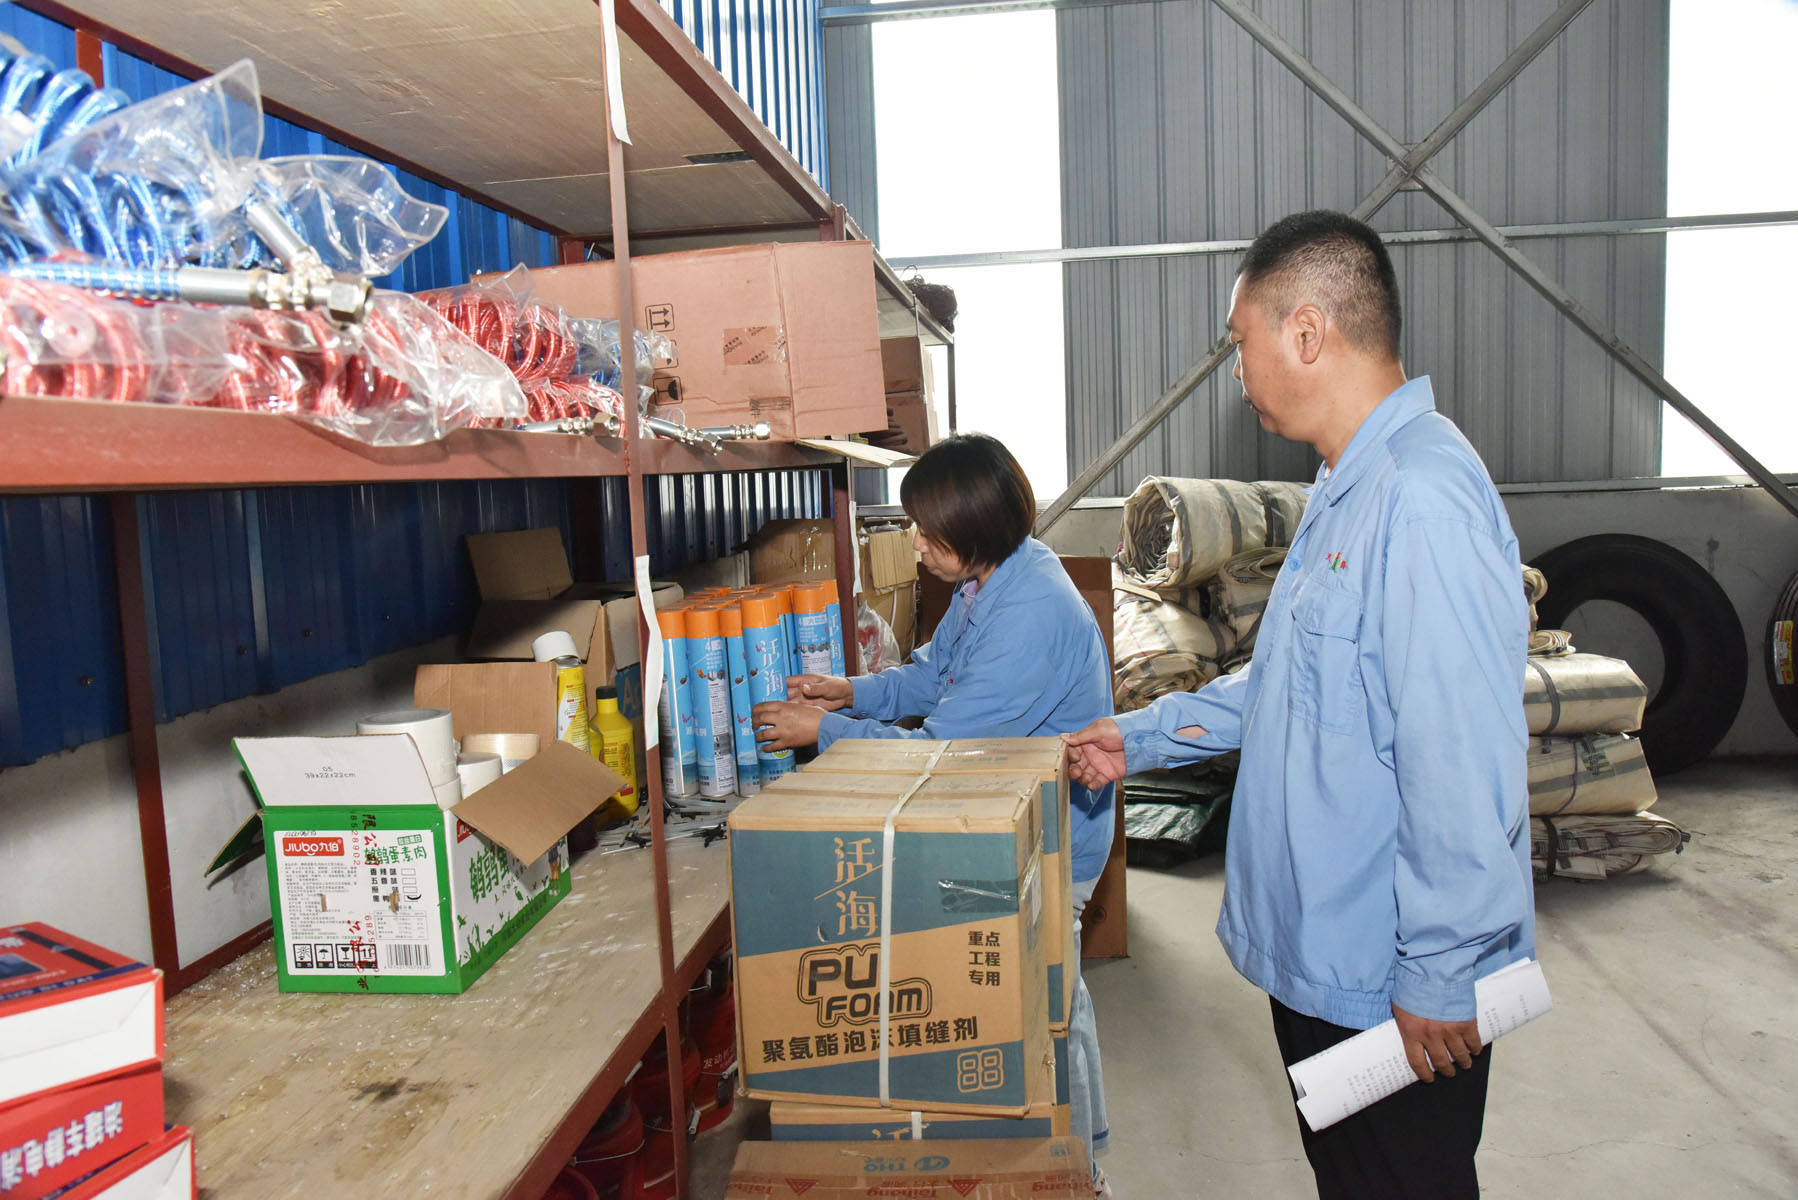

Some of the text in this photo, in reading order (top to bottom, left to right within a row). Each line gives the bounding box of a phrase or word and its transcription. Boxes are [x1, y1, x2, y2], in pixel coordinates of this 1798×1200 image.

[834, 836, 878, 936] 活海
[968, 931, 1001, 947] 重点
[968, 951, 1001, 967] 工程
[808, 953, 878, 996] PU
[968, 970, 1001, 987] 专用
[762, 1016, 978, 1063] 聚氨酯泡沫填缝剂
